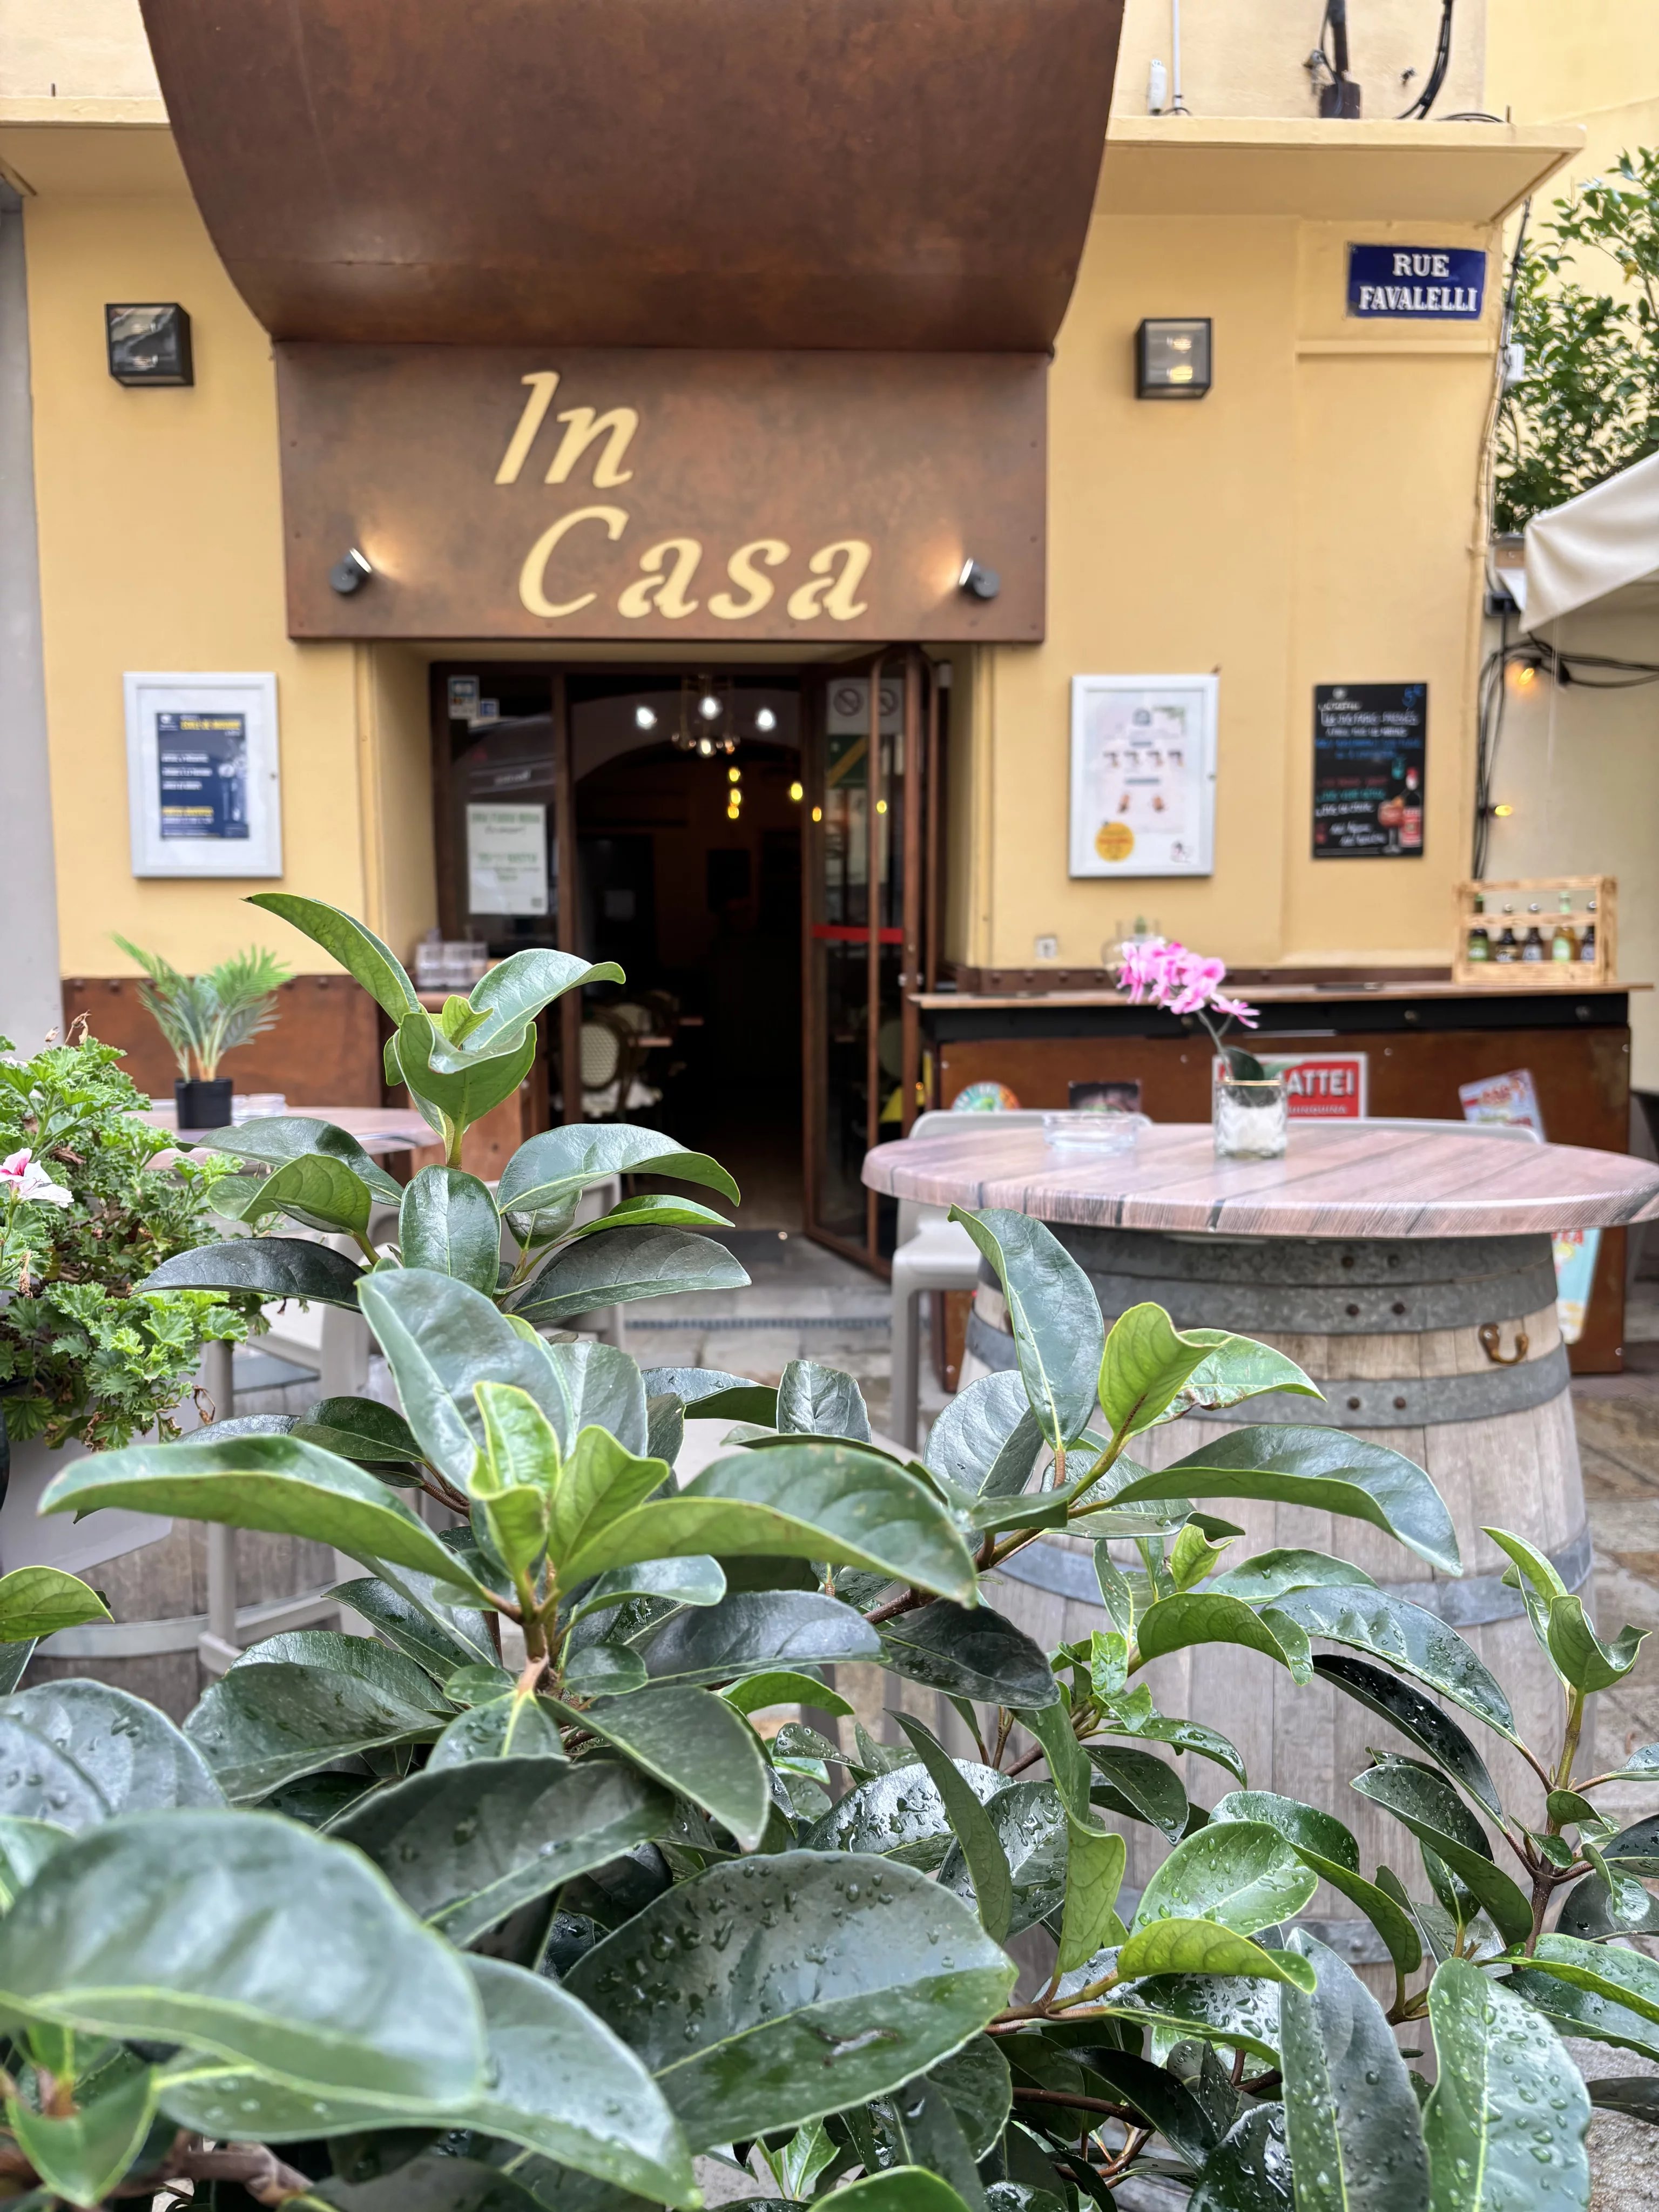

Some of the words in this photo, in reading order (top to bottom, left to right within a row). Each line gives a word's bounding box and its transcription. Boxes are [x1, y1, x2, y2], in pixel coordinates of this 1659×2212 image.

[1358, 286, 1478, 312] FAVALELLI
[1392, 253, 1449, 277] RUE
[494, 370, 639, 488] In
[519, 505, 872, 621] Casa
